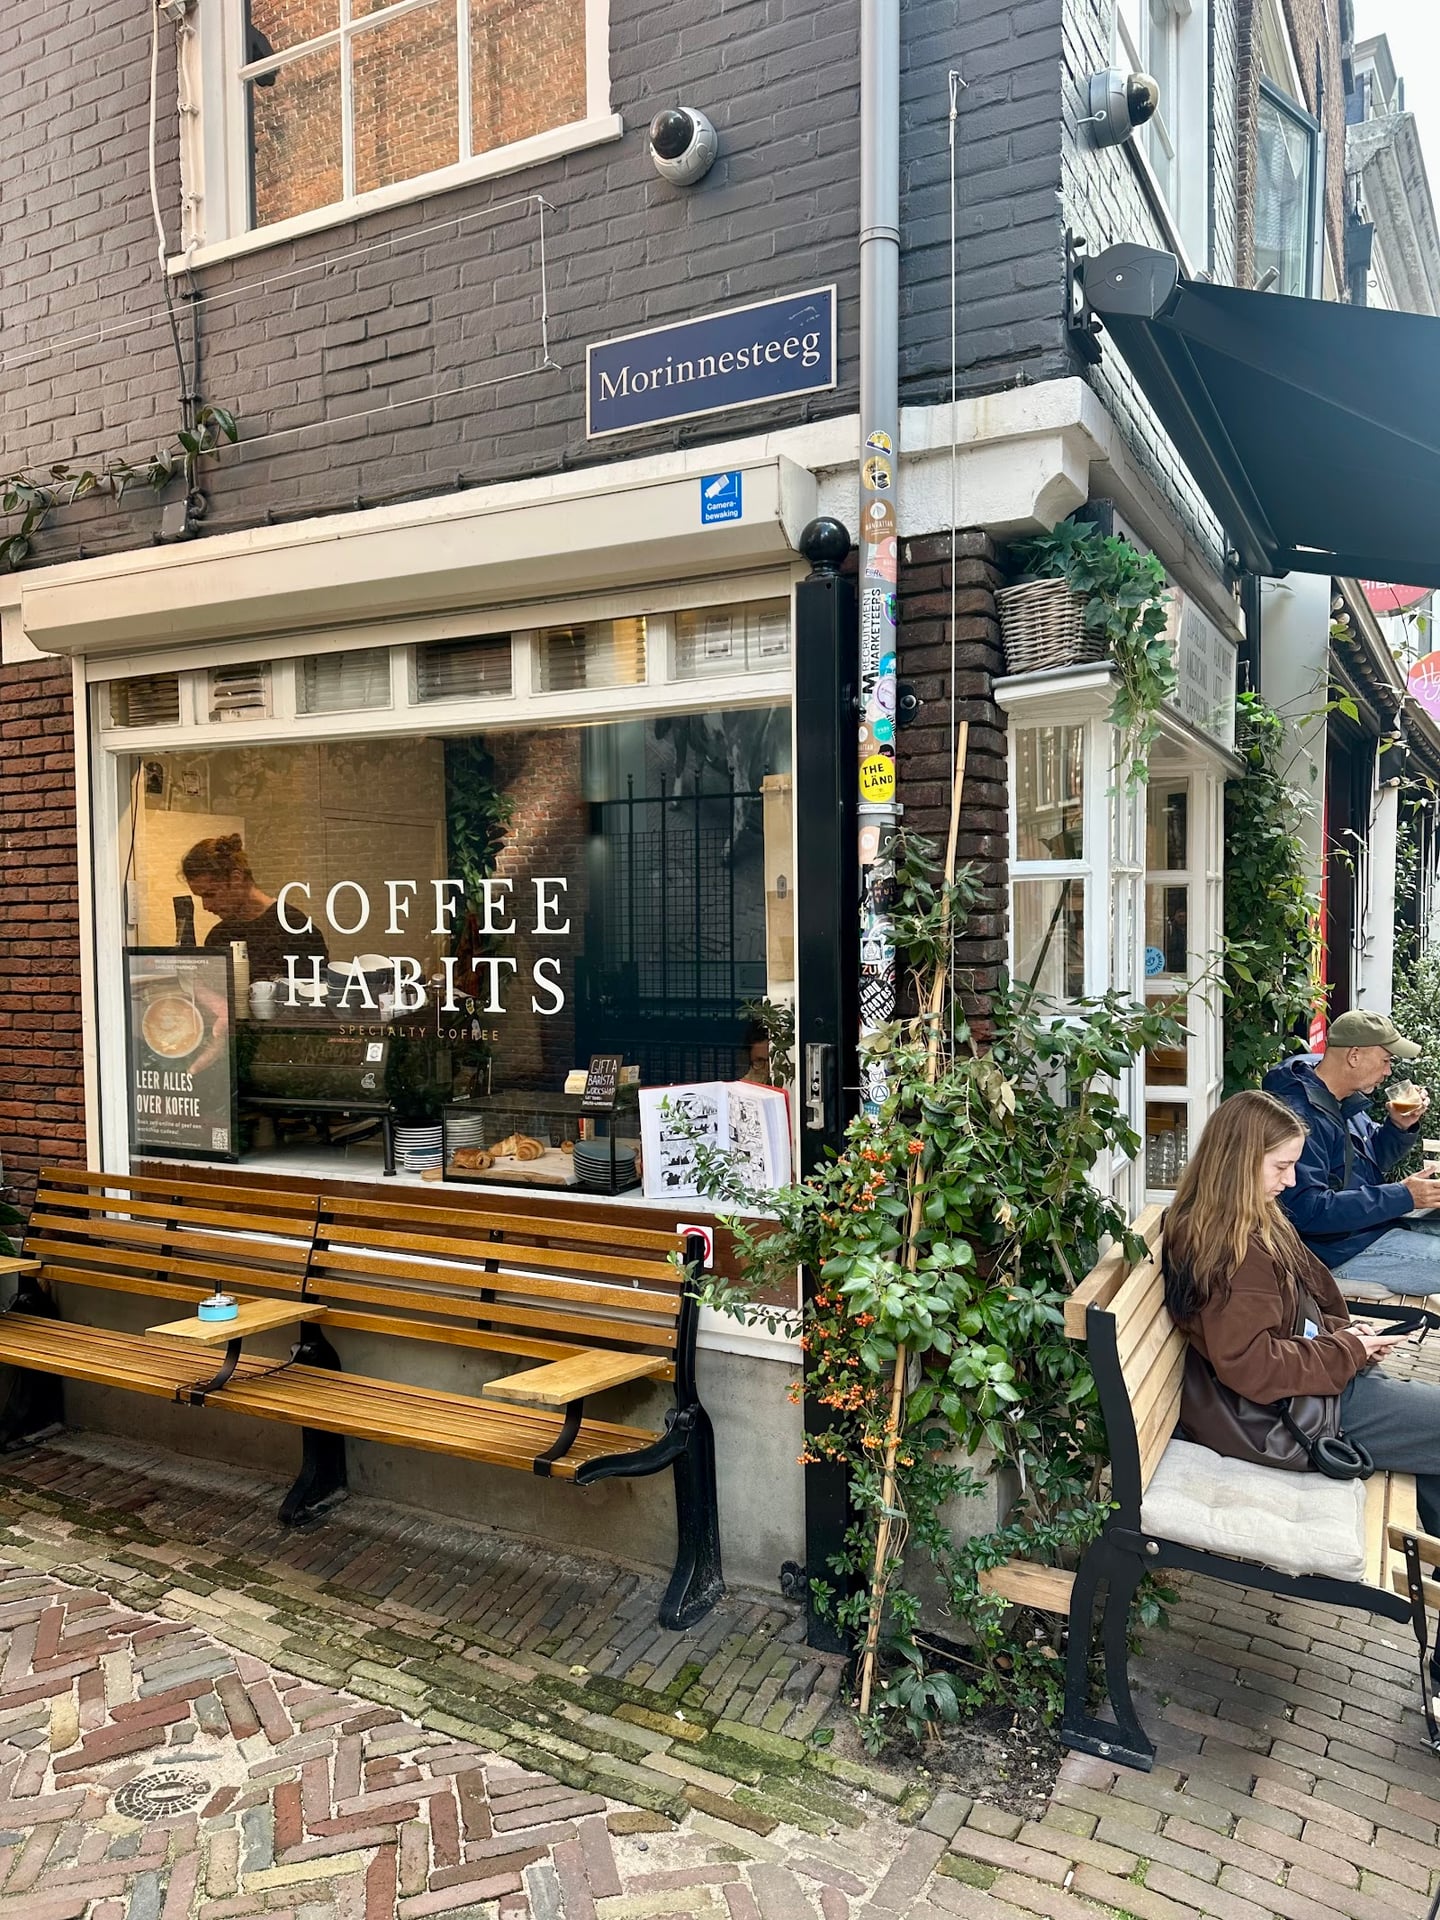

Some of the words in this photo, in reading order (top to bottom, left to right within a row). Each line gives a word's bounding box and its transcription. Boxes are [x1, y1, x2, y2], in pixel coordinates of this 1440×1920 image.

[598, 331, 821, 402] Morinnesteeg
[705, 509, 739, 521] bewaking
[706, 500, 737, 511] Camera-
[862, 591, 871, 672] RECRUITMENT
[862, 763, 884, 776] THE
[863, 775, 893, 788] LÄND
[276, 876, 571, 935] COFFEE
[282, 953, 566, 1016] HABITS
[860, 980, 882, 1002] Long
[860, 986, 892, 1018] Sleeves
[338, 1024, 426, 1039] SPECIALTY
[436, 1028, 499, 1042] COFFEE
[591, 1059, 611, 1074] GIFT
[611, 1059, 618, 1073] A
[136, 1069, 160, 1090] LEER
[163, 1071, 193, 1092] ALLES
[587, 1074, 615, 1086] BARISTA
[136, 1094, 162, 1115] OVER
[165, 1096, 201, 1117] KOFFIE
